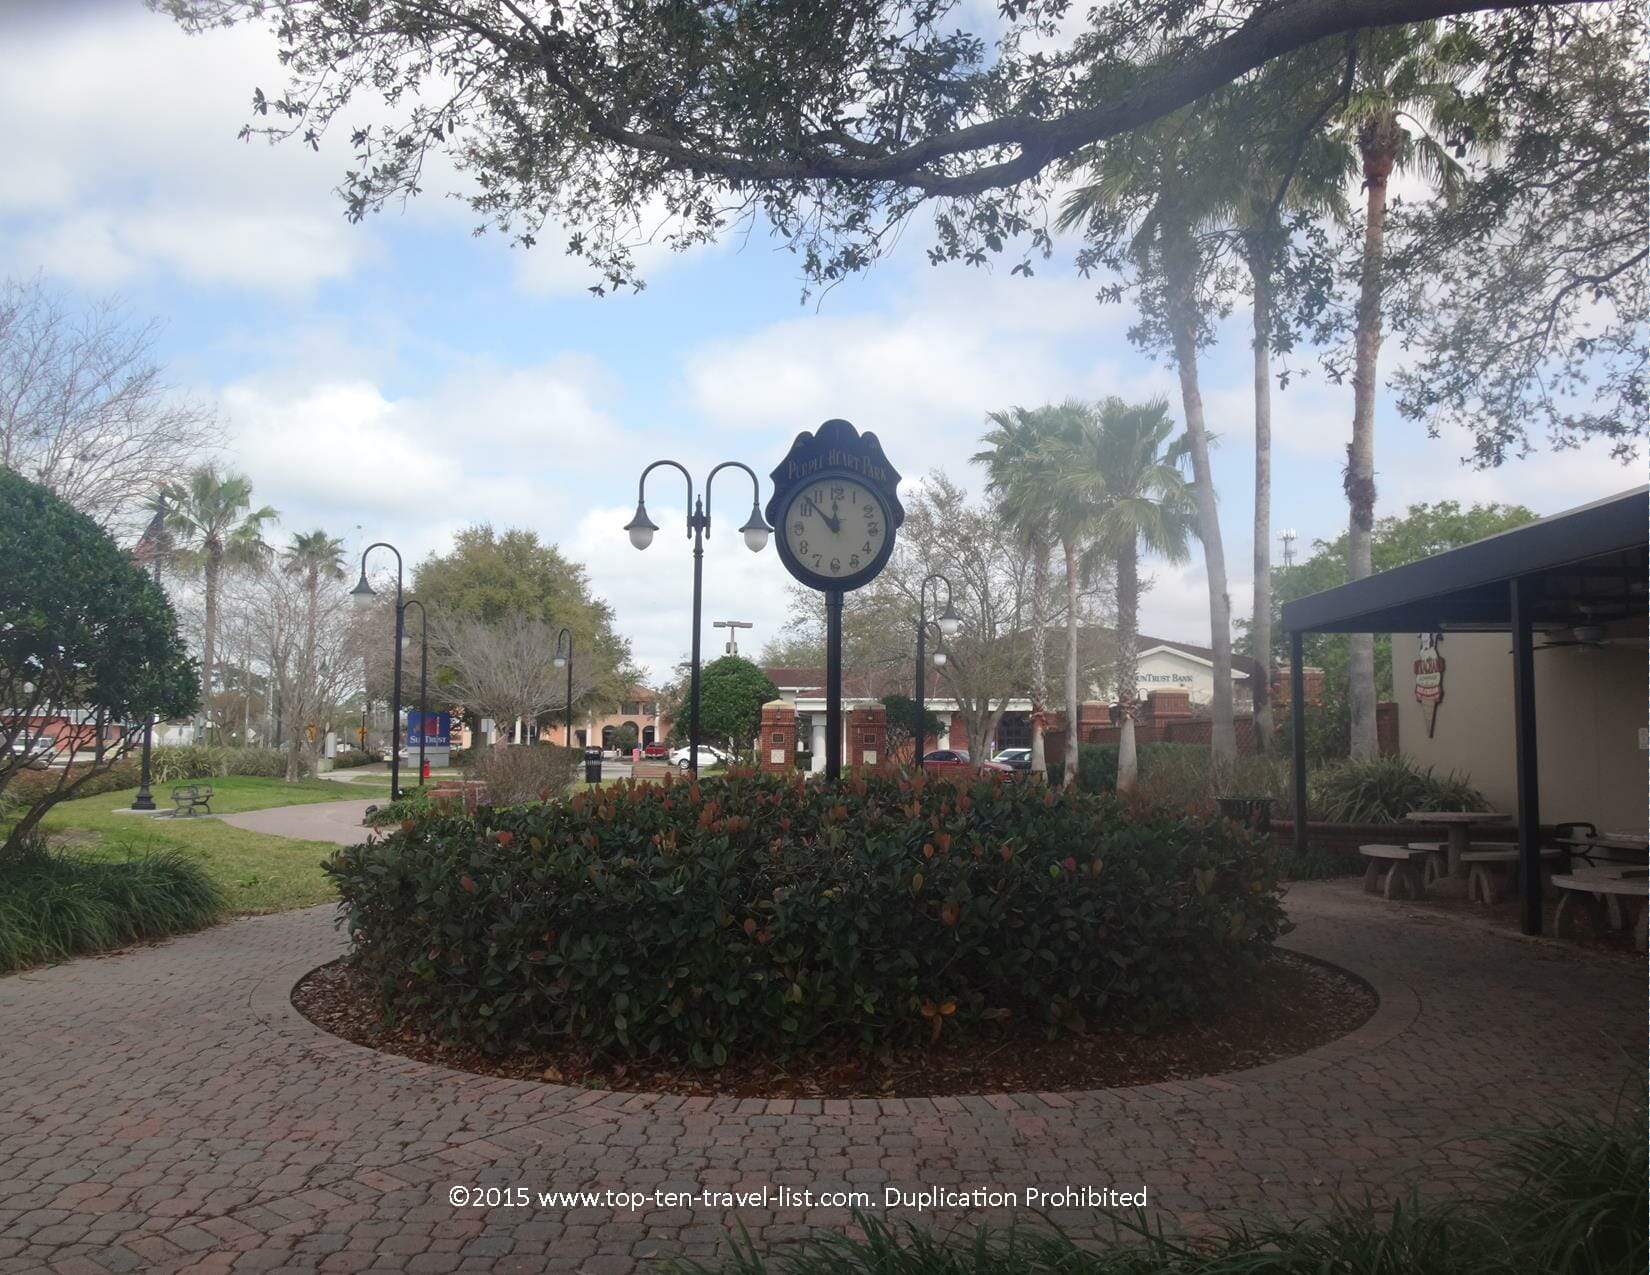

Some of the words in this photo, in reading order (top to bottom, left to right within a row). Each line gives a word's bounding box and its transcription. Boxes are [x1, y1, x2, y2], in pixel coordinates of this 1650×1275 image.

[814, 490, 823, 504] 11
[830, 487, 845, 501] 12
[863, 504, 874, 519] 2
[794, 521, 804, 536] 9
[867, 521, 879, 537] 3
[800, 540, 809, 555] 8
[862, 541, 872, 555] 4
[812, 553, 823, 568] 7
[830, 557, 841, 573] 6
[849, 554, 860, 569] 5
[1136, 673, 1171, 682] UNTRUST
[1172, 673, 1193, 682] BANK
[409, 735, 447, 744] SUTRUST
